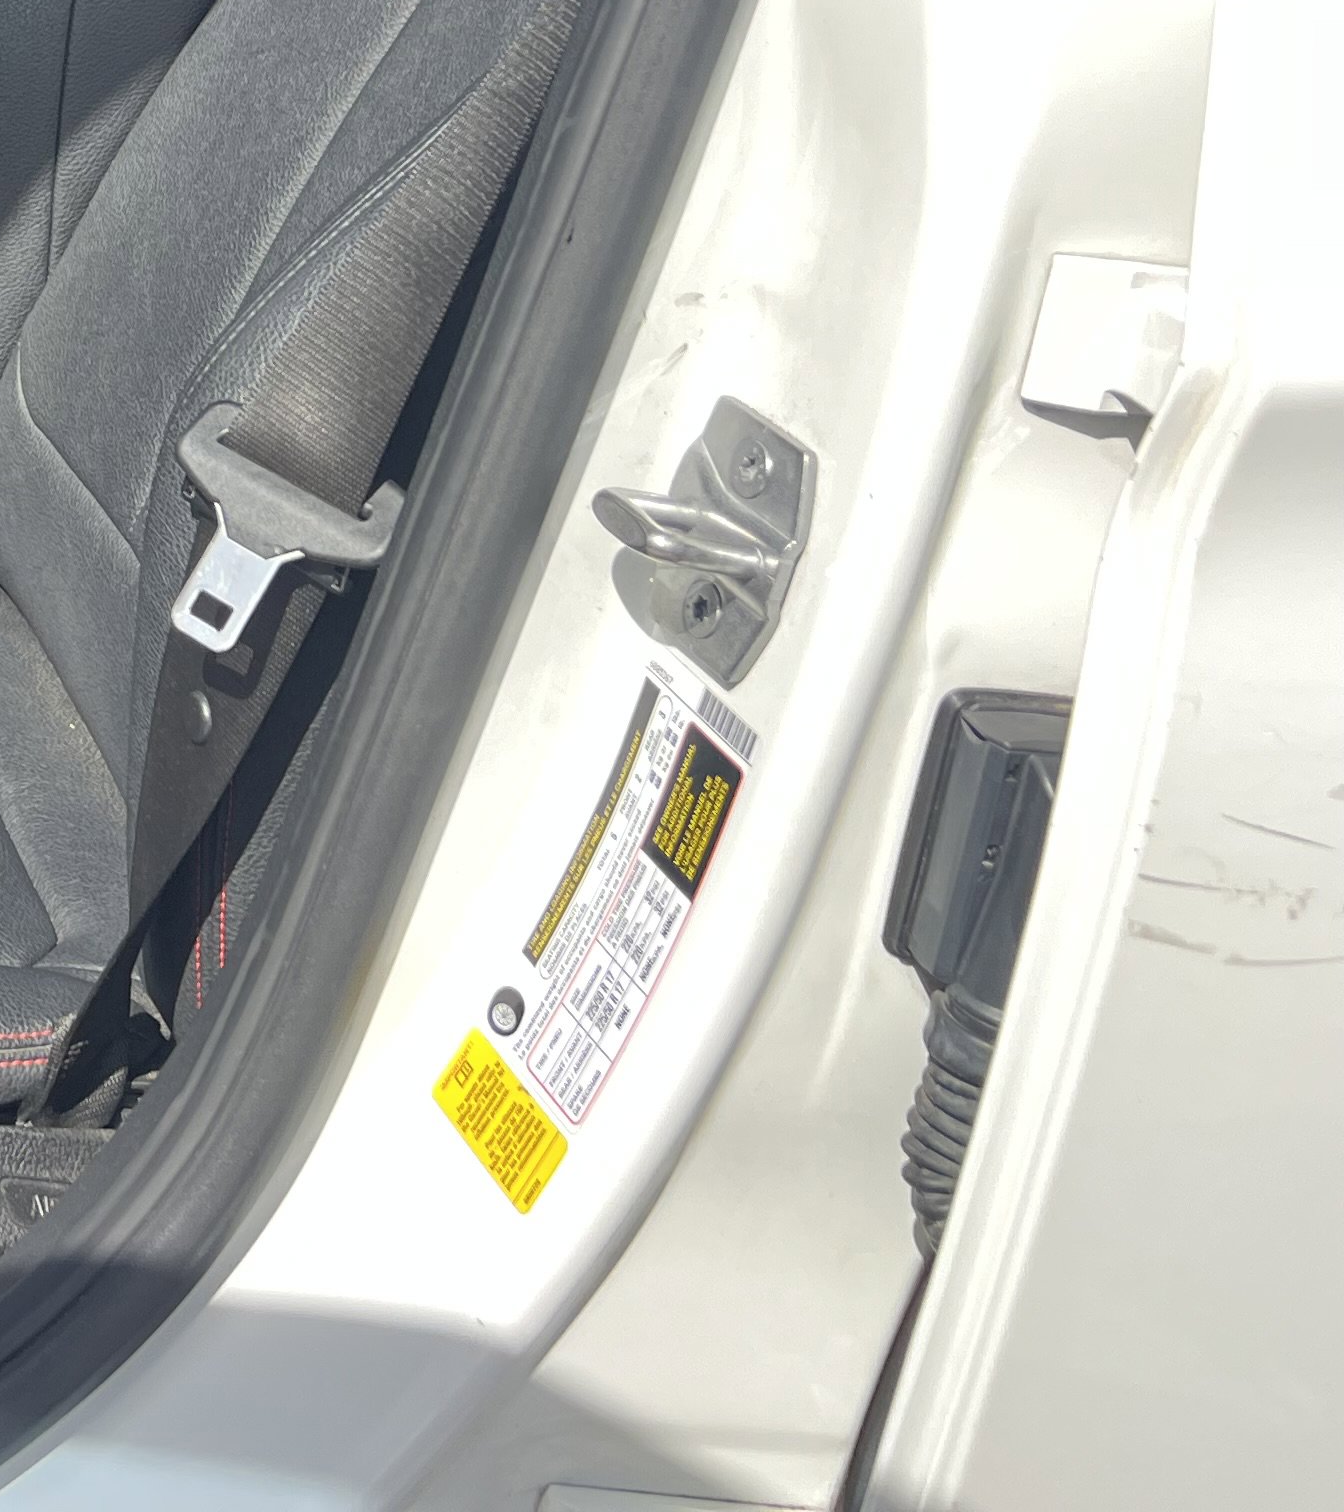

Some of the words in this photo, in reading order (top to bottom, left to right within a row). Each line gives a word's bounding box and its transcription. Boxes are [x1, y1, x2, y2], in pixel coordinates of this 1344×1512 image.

[677, 742, 697, 782] MANUAL
[665, 793, 694, 857] INFORMATION
[585, 990, 605, 1021] 225/50
[604, 969, 615, 985] 17
[595, 1001, 614, 1032] 225/50
[614, 981, 625, 996] 17
[614, 1004, 630, 1030] NONE
